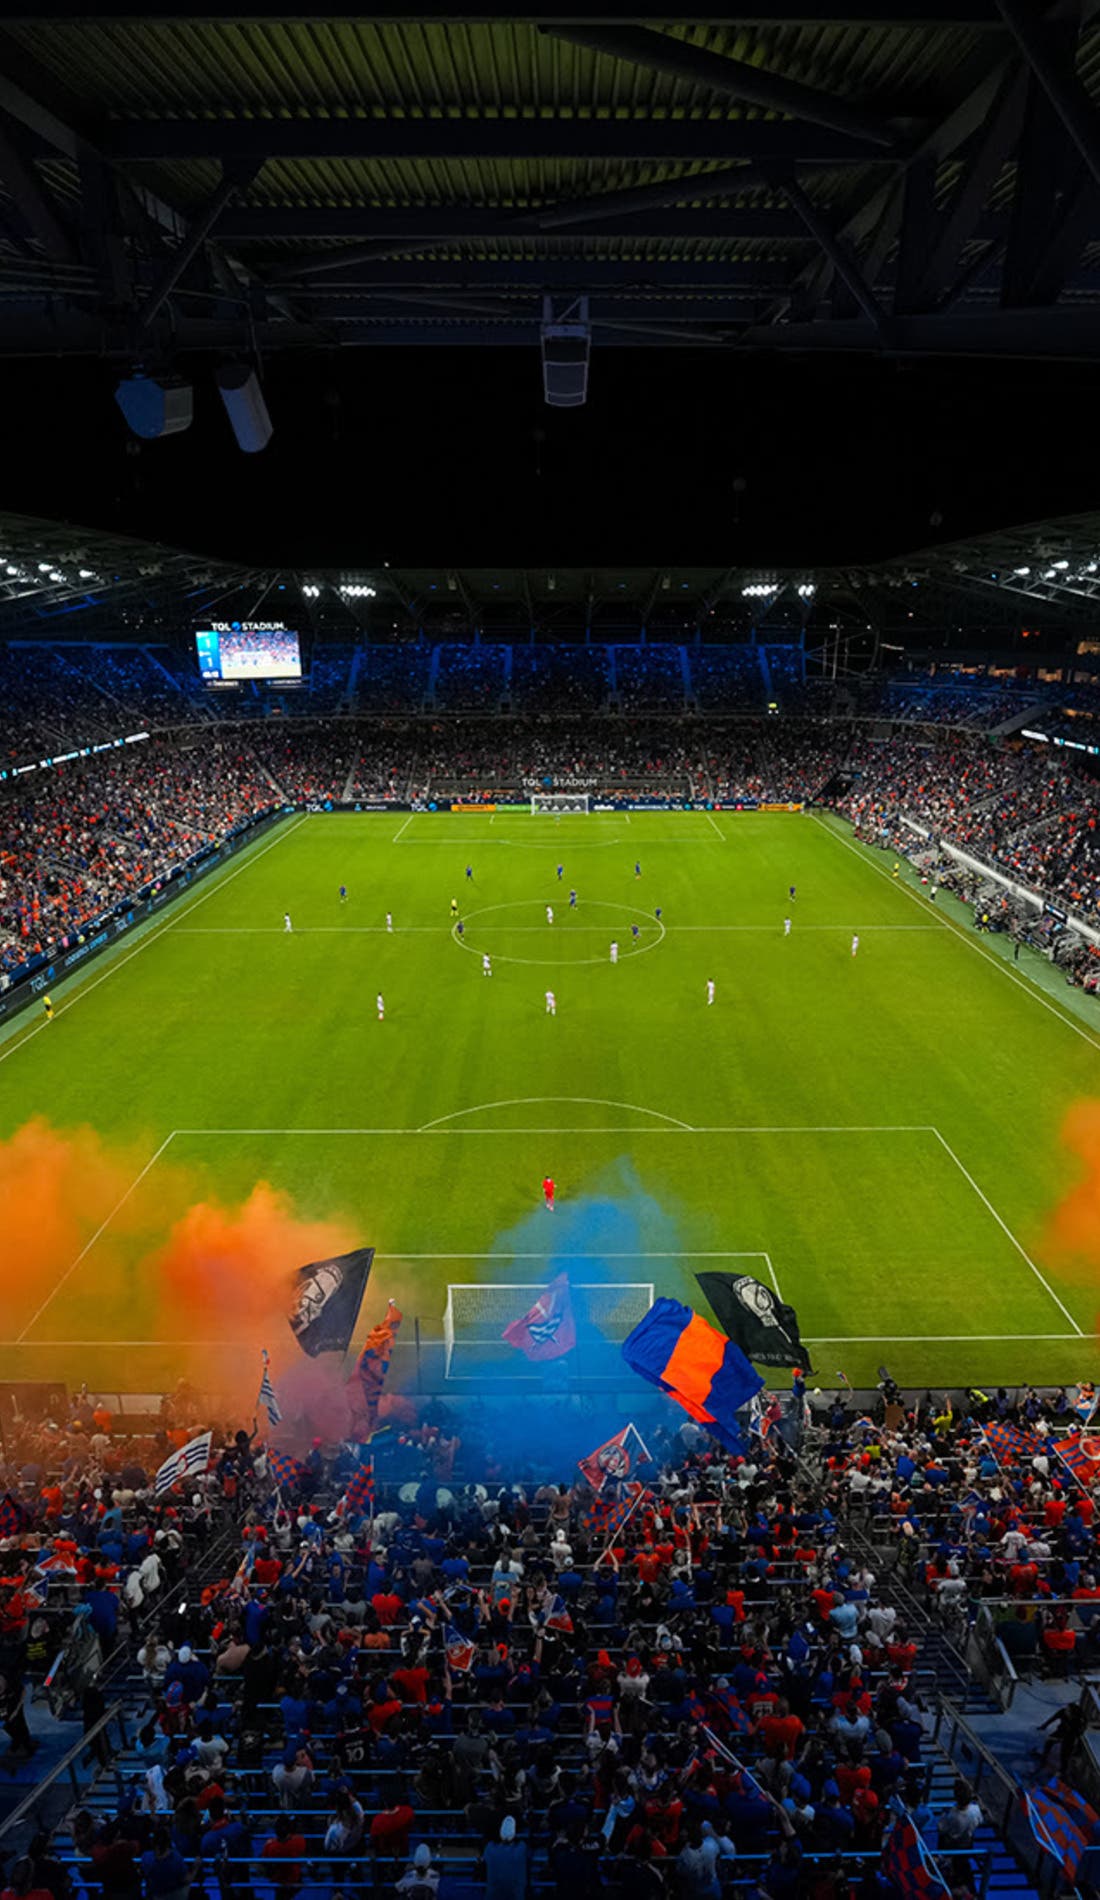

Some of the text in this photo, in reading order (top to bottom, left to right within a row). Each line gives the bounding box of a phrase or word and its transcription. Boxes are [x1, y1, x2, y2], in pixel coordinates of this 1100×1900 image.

[242, 622, 284, 631] STADIUM
[553, 777, 597, 787] STADIUM
[345, 1747, 365, 1762] 10
